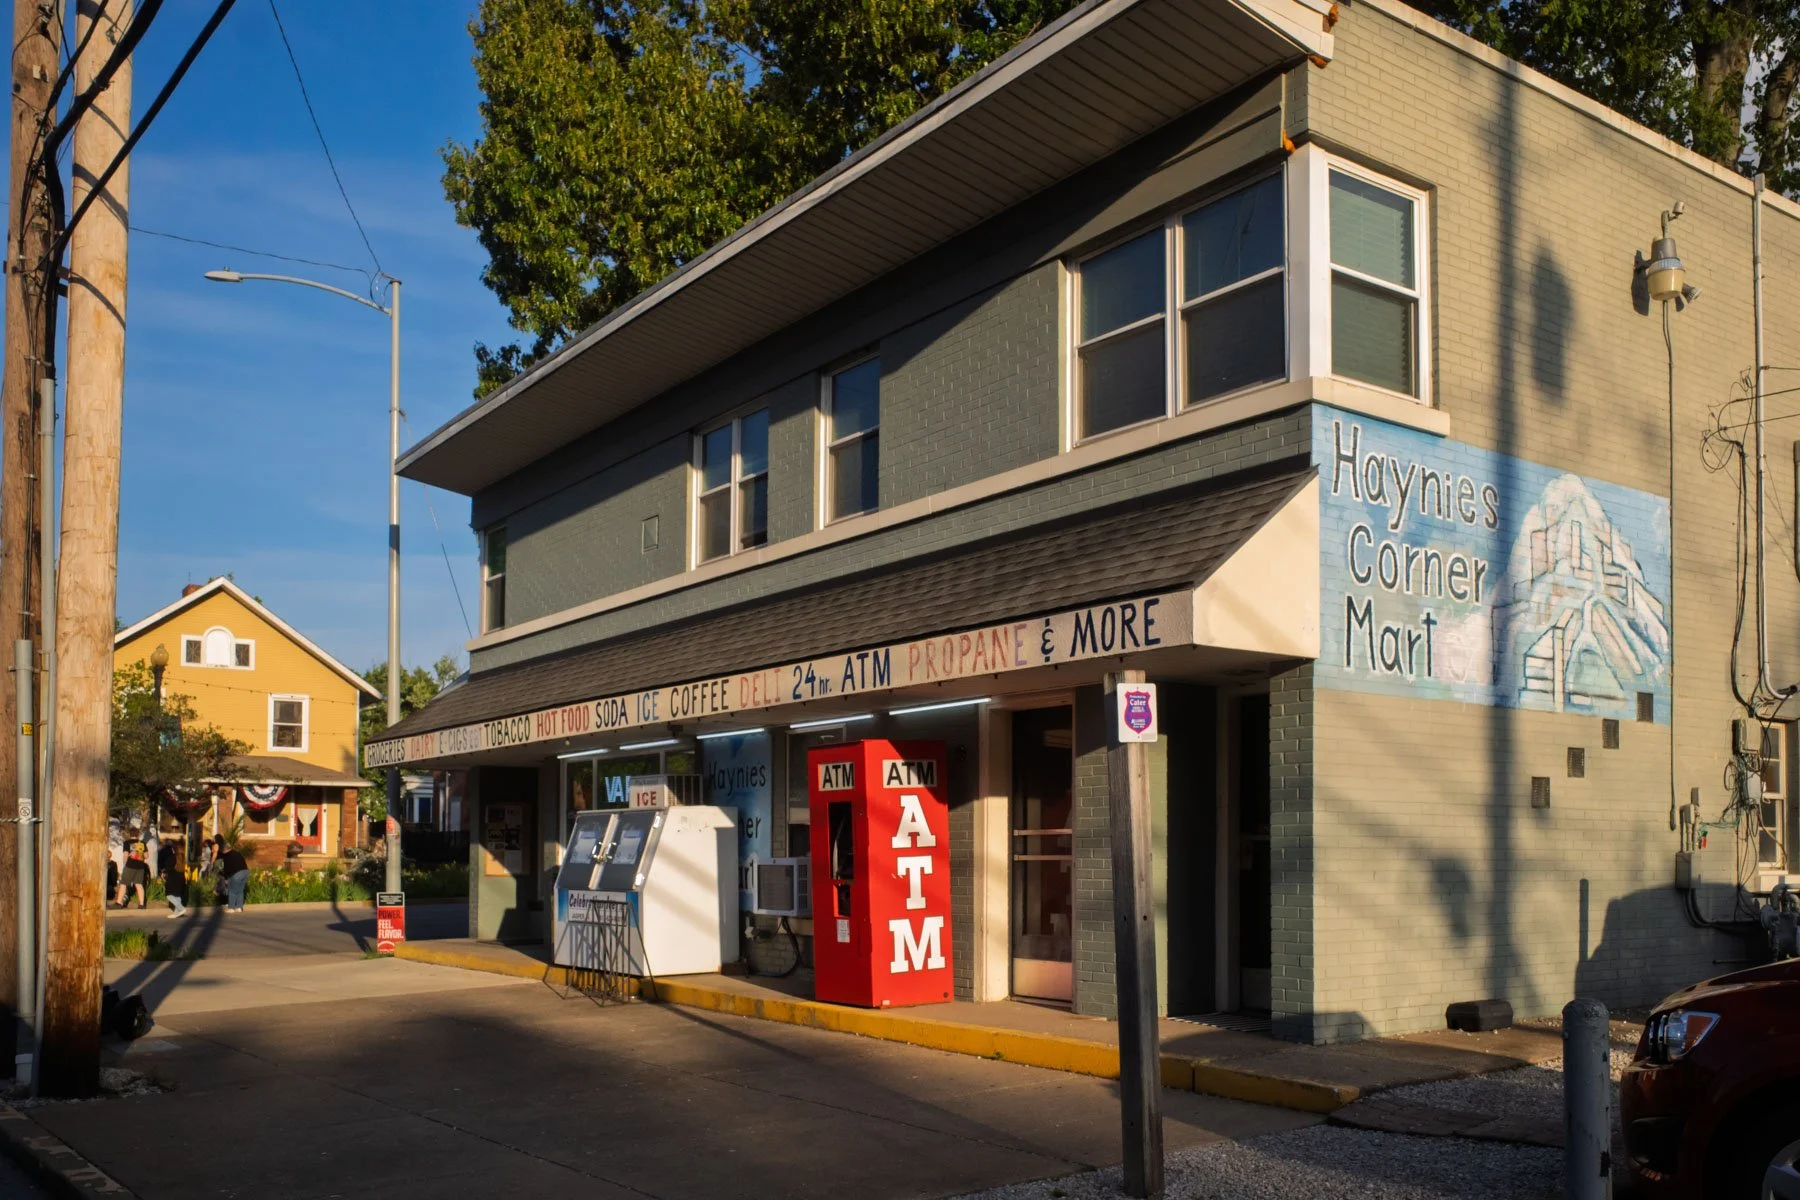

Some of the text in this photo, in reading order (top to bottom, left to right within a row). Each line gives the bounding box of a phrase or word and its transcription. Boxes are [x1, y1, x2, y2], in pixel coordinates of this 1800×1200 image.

[1332, 420, 1499, 531] Haynies
[1348, 523, 1488, 603] Corner
[1344, 594, 1438, 678] Mart
[367, 739, 405, 766] GROCERIES
[410, 734, 435, 759] DAIRY
[484, 715, 531, 746] TOBACCO
[536, 710, 558, 738] HOT
[561, 705, 590, 734] FOOD
[595, 698, 629, 729] SODA
[636, 691, 660, 723] ICE
[670, 679, 729, 718] COFFEE
[740, 668, 781, 709] DELI
[841, 648, 891, 693] ATM
[907, 623, 1028, 682] PROPANE
[1069, 598, 1161, 658] MORE
[636, 791, 657, 807] ICE
[822, 763, 855, 789] ATM
[886, 761, 934, 786] ATM
[890, 794, 946, 974] ATM
